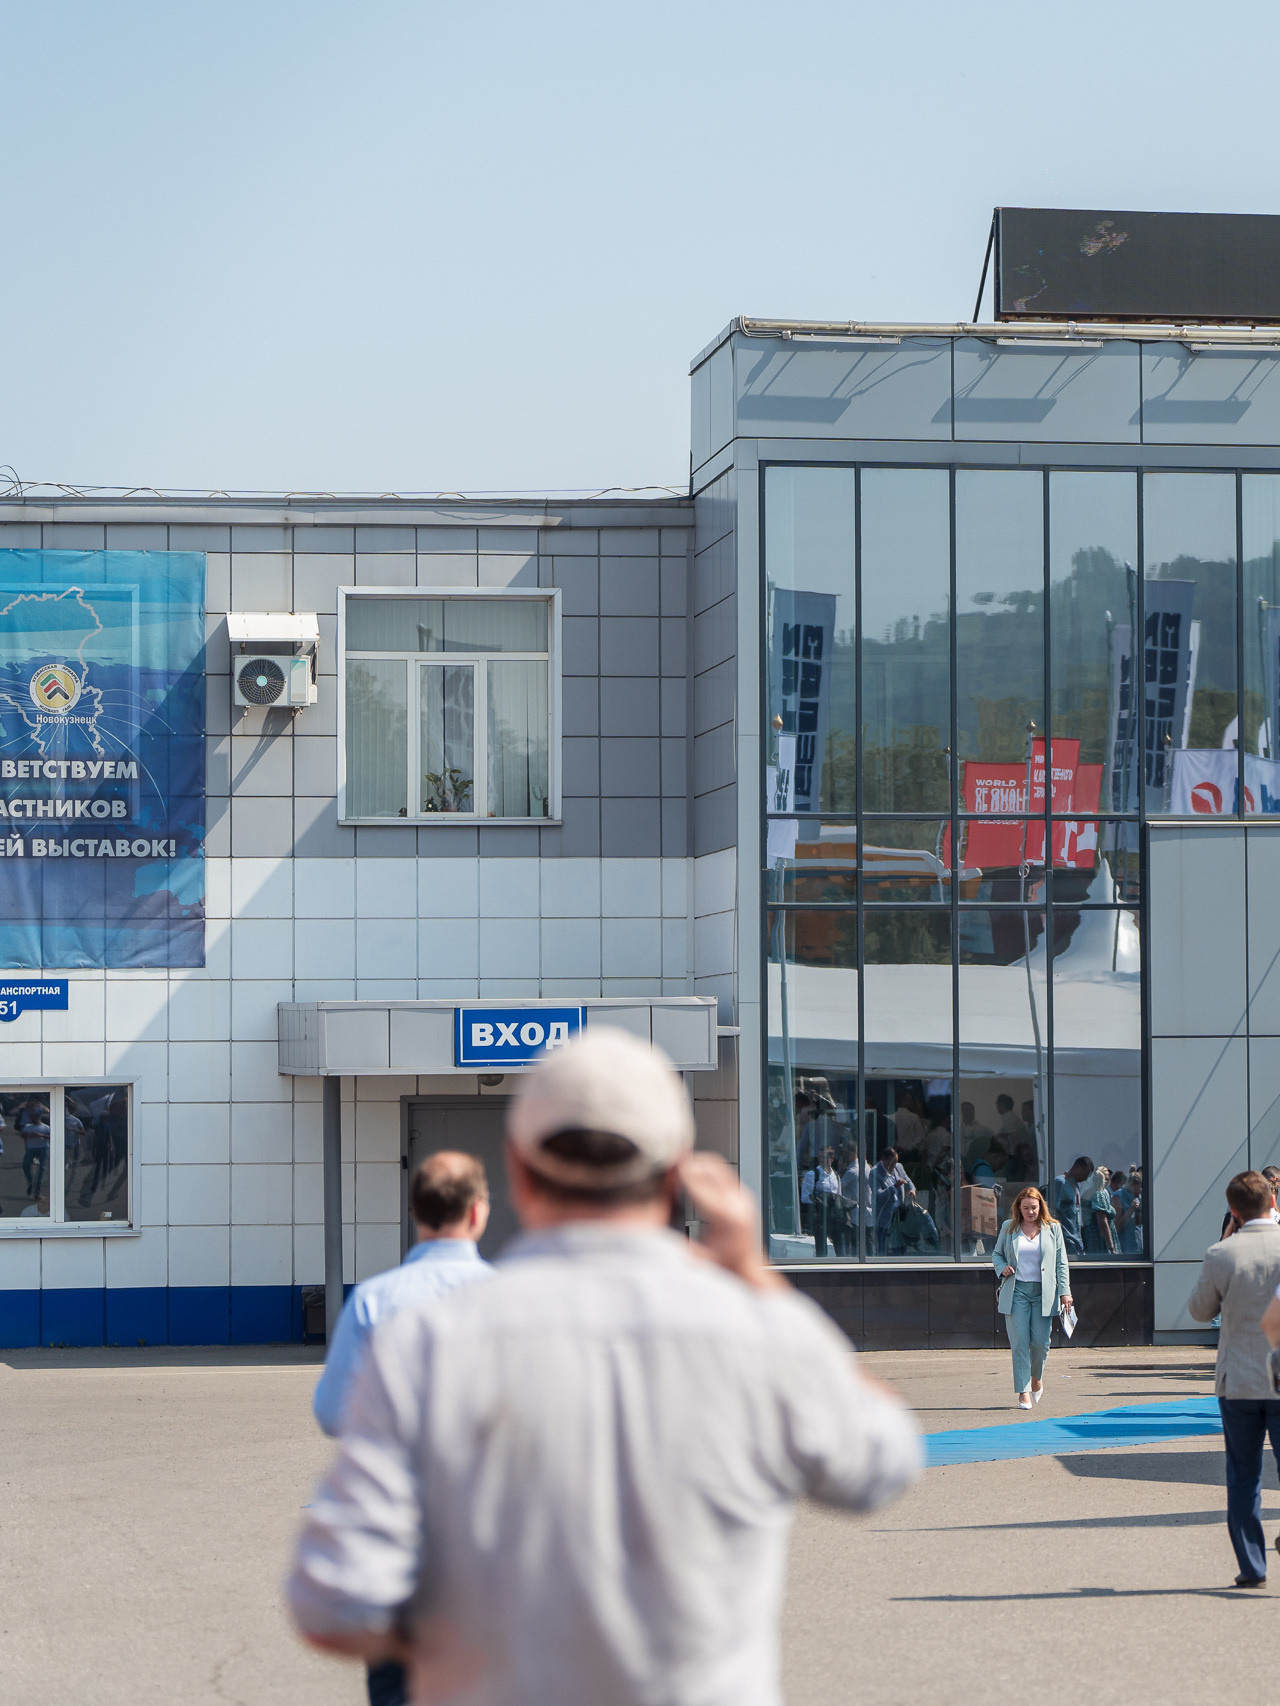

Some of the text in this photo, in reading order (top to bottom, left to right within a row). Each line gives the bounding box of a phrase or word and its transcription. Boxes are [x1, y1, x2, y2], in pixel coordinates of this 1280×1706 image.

[36, 714, 97, 725] Новокузнецк
[1, 760, 138, 779] ВЕТСТВУЕМ
[975, 779, 1017, 787] WORLD
[32, 838, 176, 858] ВЫСТАВОК!
[471, 1022, 571, 1050] ВХОД
